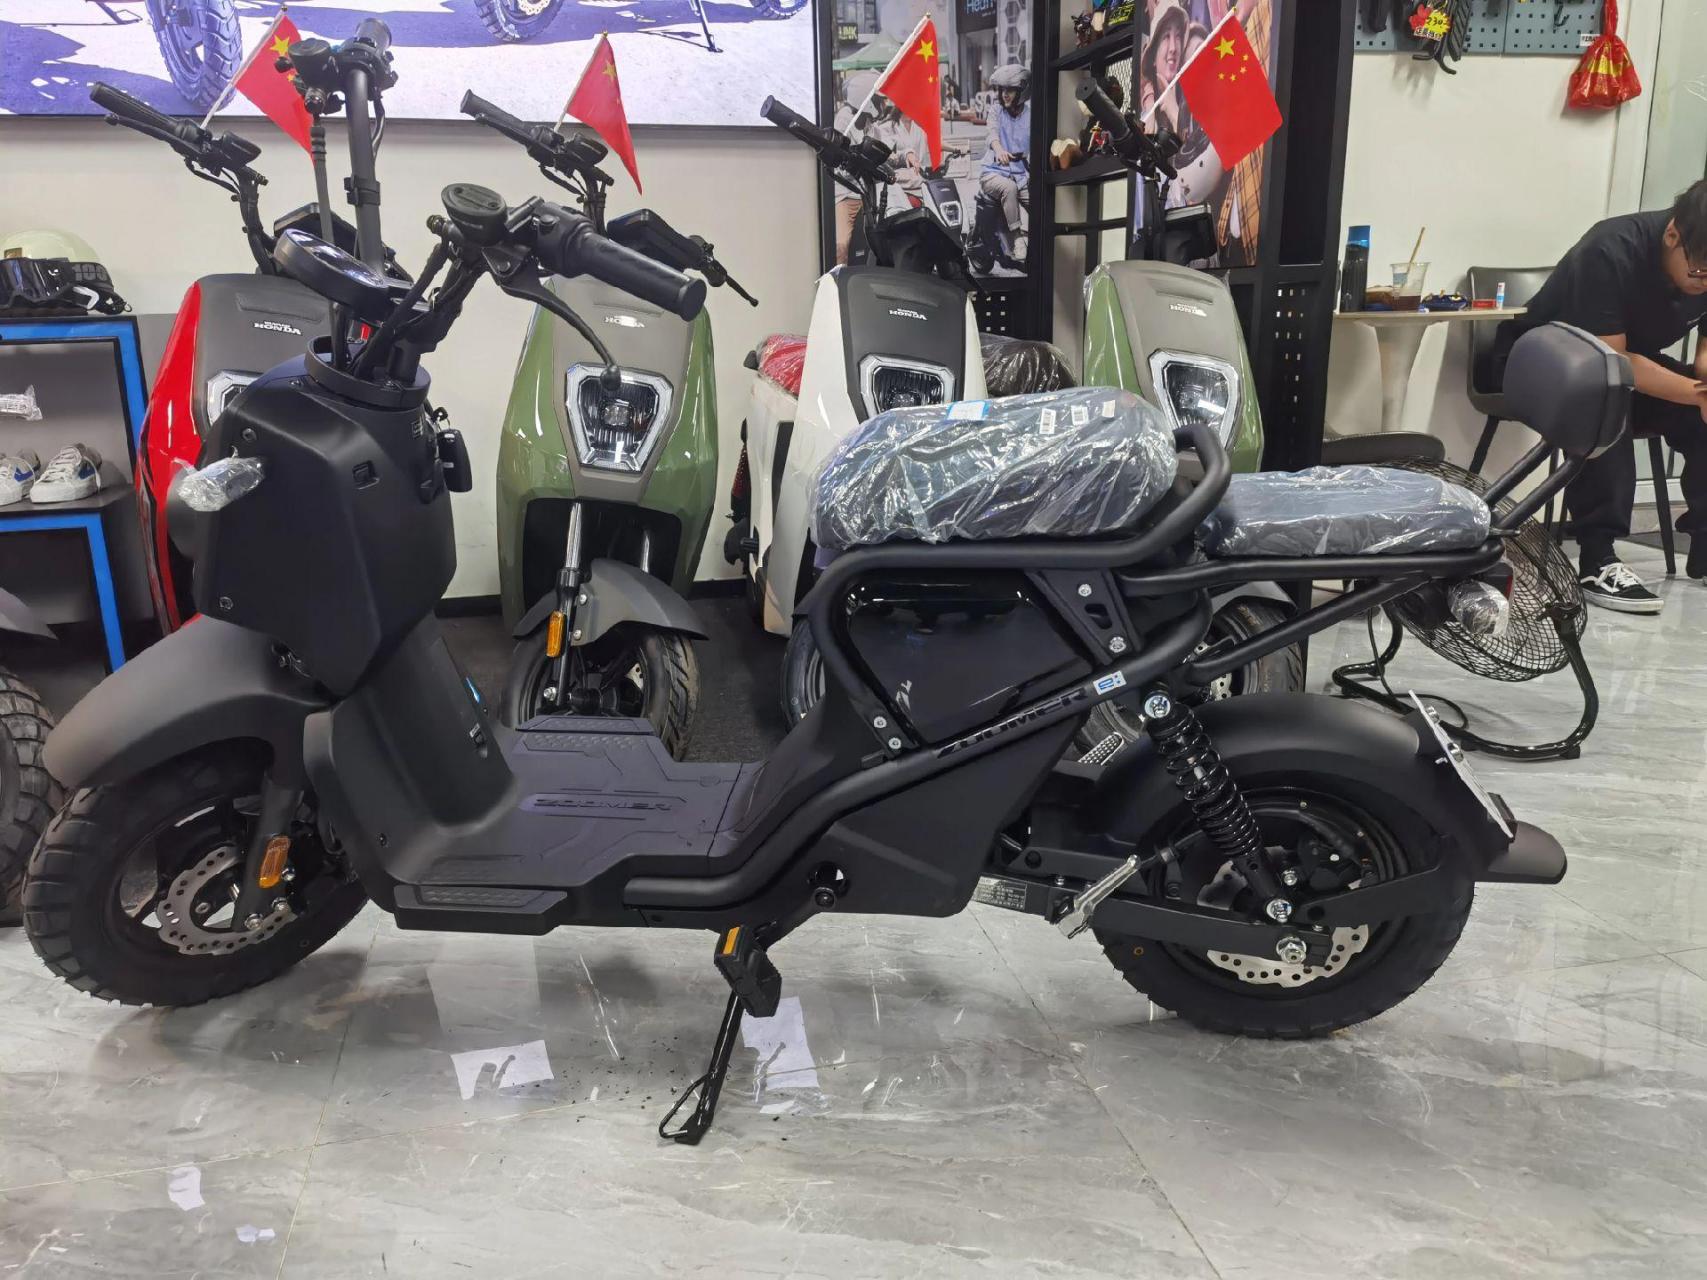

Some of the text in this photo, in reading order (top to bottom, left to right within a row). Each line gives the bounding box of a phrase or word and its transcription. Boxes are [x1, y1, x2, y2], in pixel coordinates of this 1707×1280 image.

[889, 309, 928, 321] HONDA
[253, 322, 302, 335] HONDA
[937, 686, 1088, 759] ZOOMER
[534, 798, 672, 812] ZOOMER
